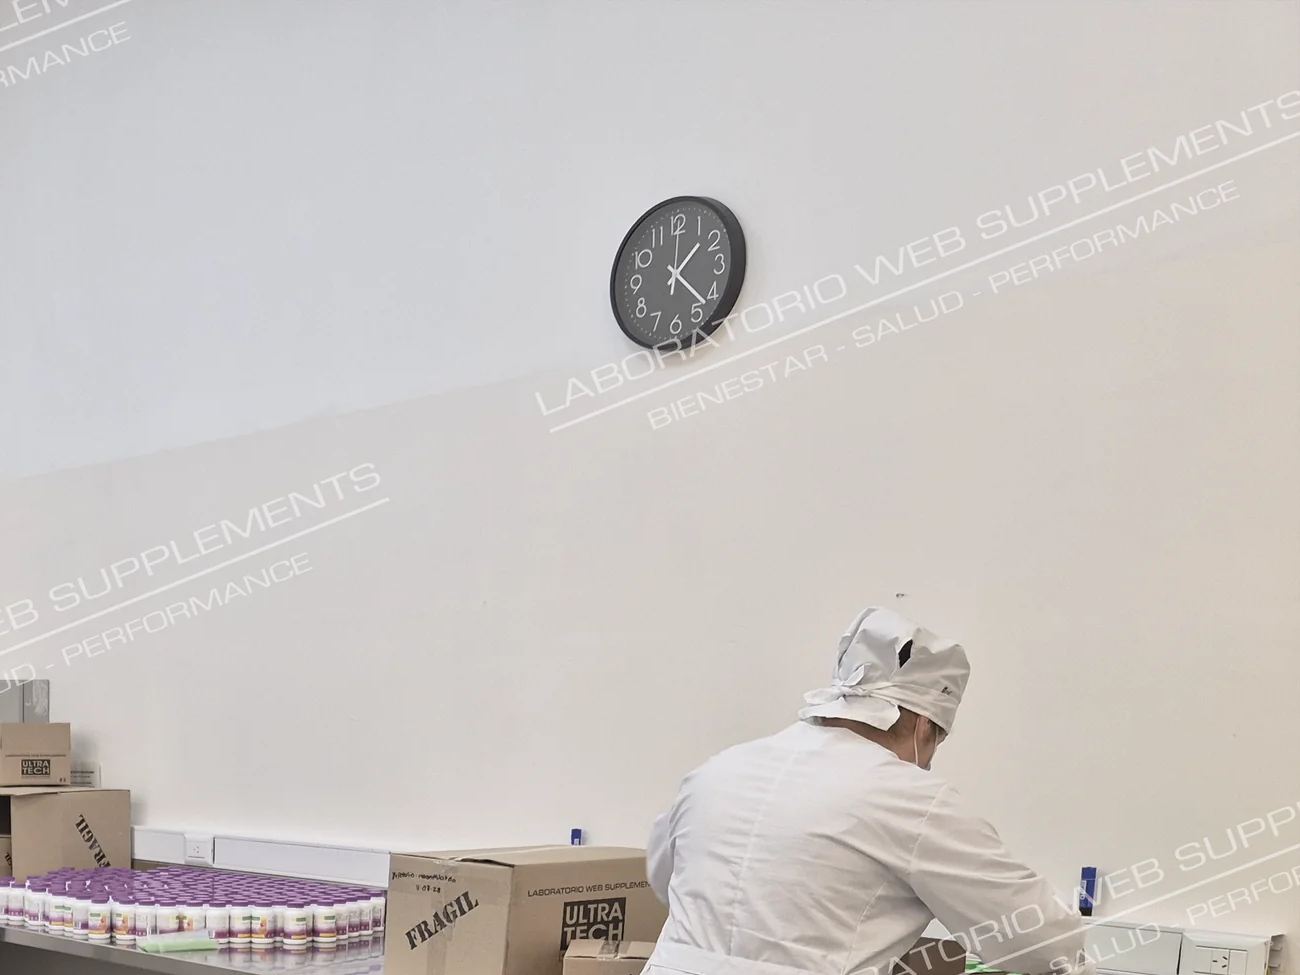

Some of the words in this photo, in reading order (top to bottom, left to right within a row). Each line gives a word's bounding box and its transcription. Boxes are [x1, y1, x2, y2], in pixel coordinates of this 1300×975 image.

[670, 214, 686, 235] 12
[697, 216, 701, 235] 1
[651, 226, 663, 248] 11
[707, 229, 721, 251] 2
[634, 249, 653, 270] 10
[713, 253, 726, 275] 3
[630, 274, 642, 295] 9
[706, 281, 719, 301] 4
[635, 297, 647, 318] 8
[691, 302, 704, 323] 5
[650, 312, 663, 332] 7
[669, 314, 682, 334] 6
[22, 760, 49, 768] ULTRA
[22, 767, 50, 775] TECH
[528, 886, 584, 897] LABORATORIO
[586, 884, 603, 892] WEB
[405, 891, 479, 950] FRAGIL
[566, 902, 623, 925] ULTRA
[563, 922, 623, 947] TECH
